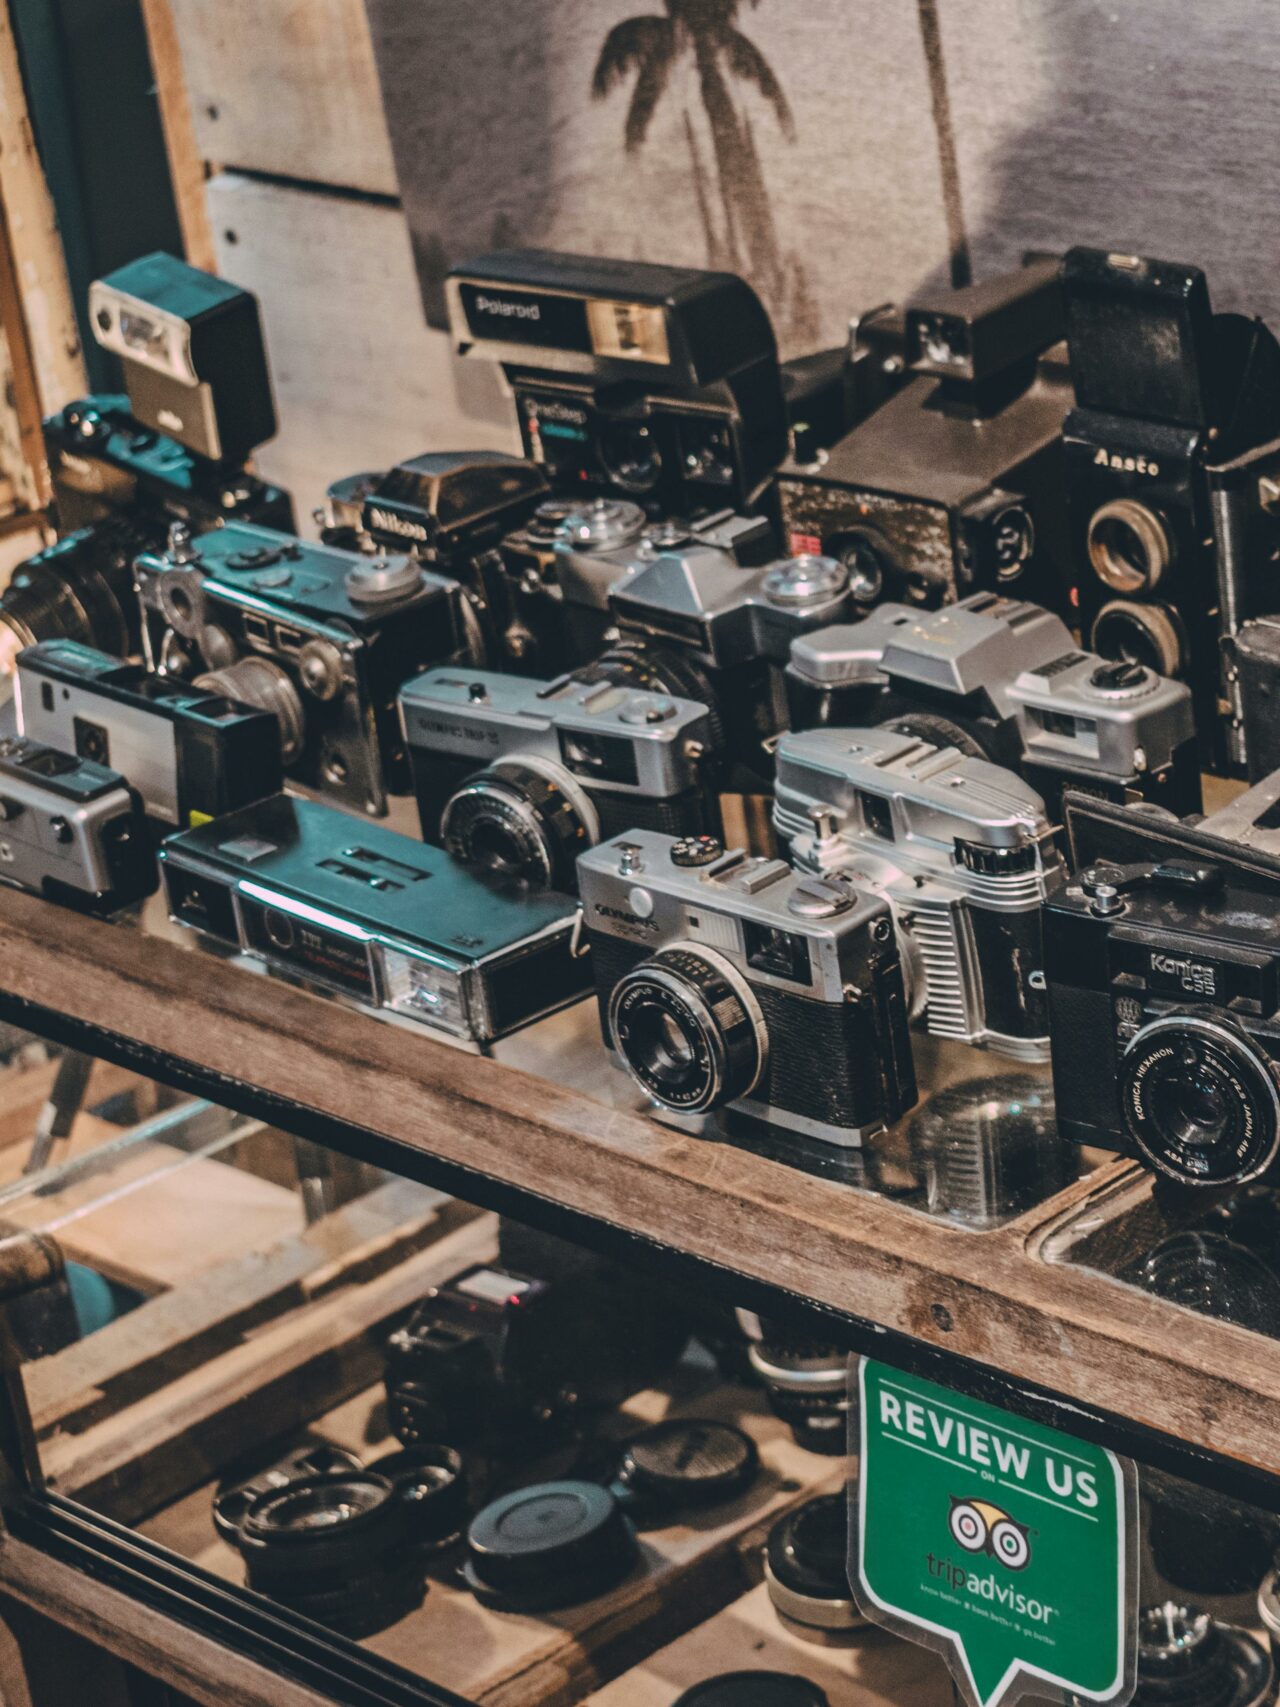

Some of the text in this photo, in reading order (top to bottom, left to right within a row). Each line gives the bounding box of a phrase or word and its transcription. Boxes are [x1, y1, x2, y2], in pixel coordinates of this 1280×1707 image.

[476, 296, 540, 320] Polaroid
[1094, 448, 1159, 476] Ansco
[371, 507, 427, 541] Nikon
[1150, 953, 1216, 983] Konica
[1136, 1048, 1175, 1078] HEXANON
[1132, 1081, 1145, 1121] KONICA
[1243, 1104, 1253, 1139] JAPAN
[879, 1389, 1099, 1508] REVIEW US
[980, 1470, 996, 1483] ON
[926, 1552, 1054, 1625] tripadvisor
